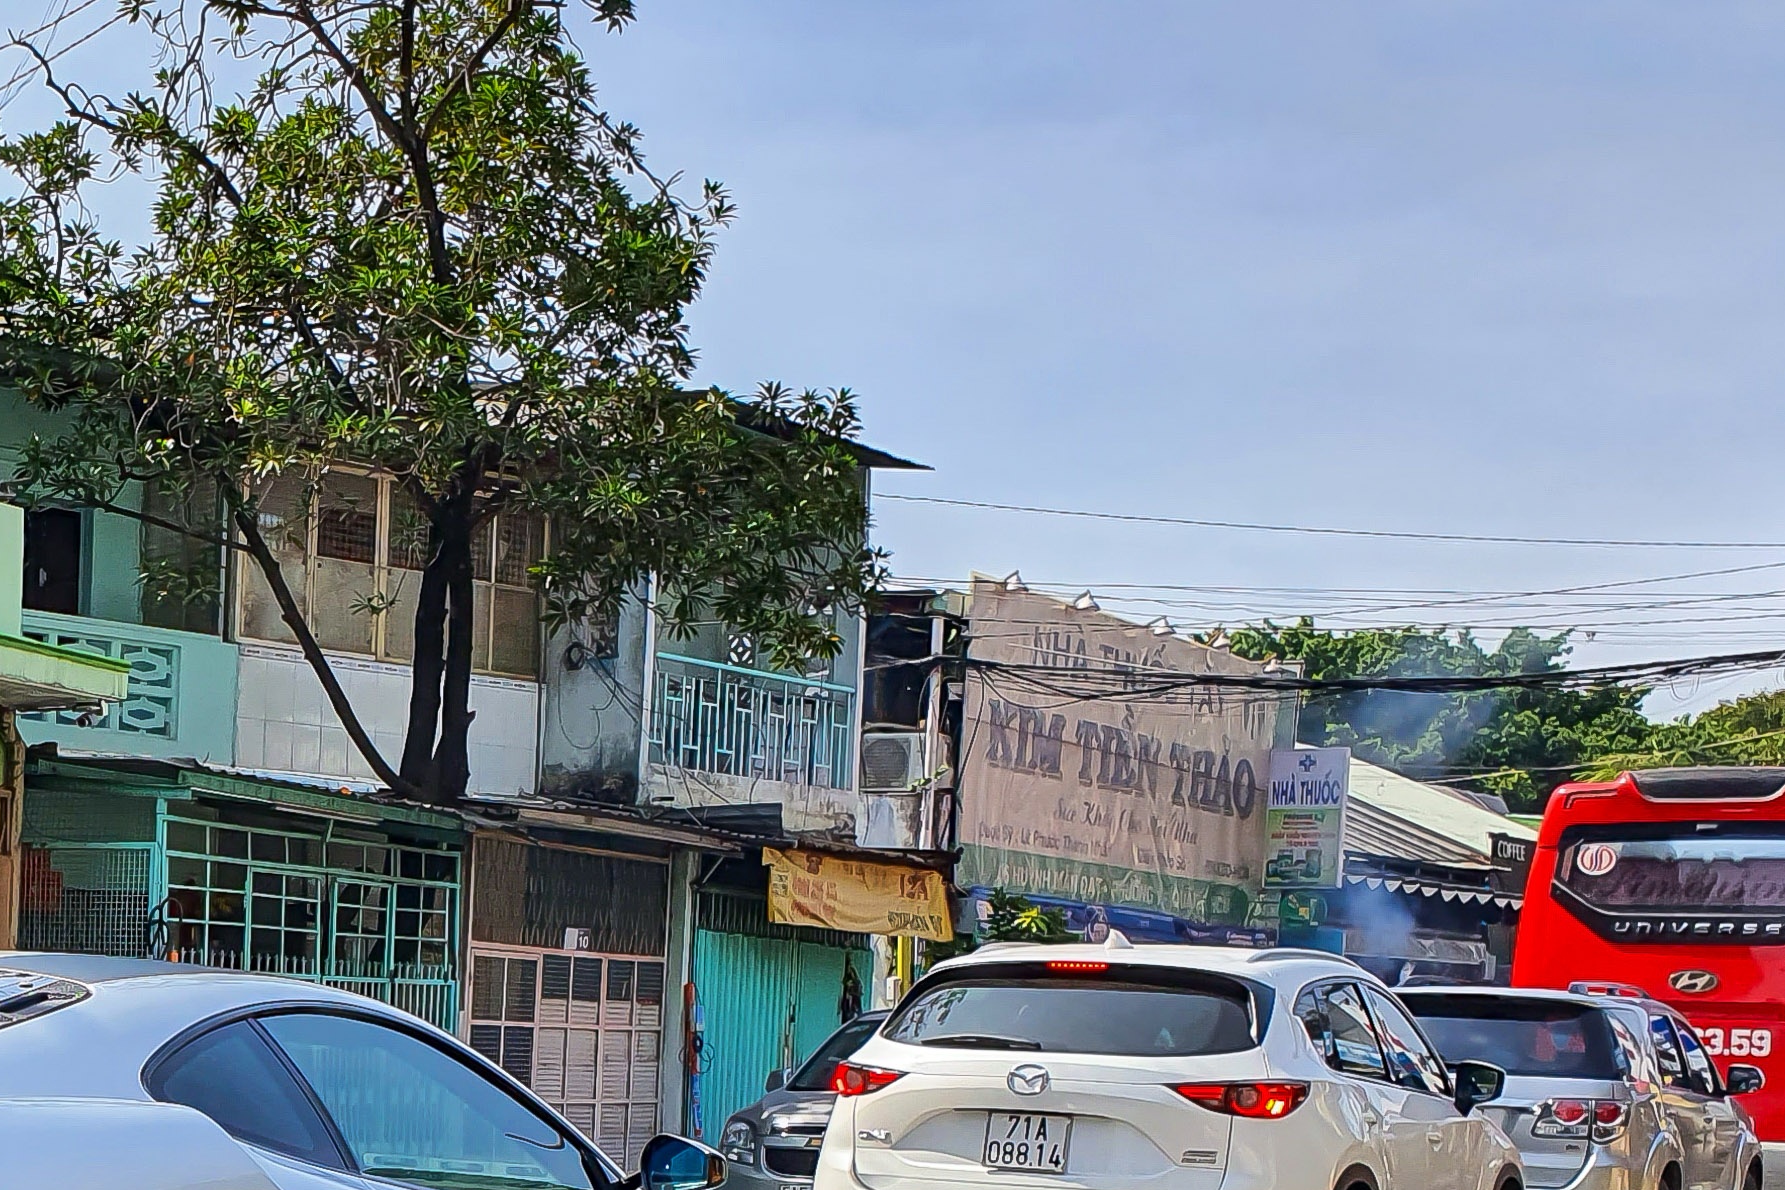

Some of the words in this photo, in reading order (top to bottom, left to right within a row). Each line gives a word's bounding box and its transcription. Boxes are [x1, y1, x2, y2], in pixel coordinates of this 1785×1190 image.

[1272, 772, 1296, 805] NHÀ
[1300, 769, 1341, 805] THUỐC
[1497, 839, 1526, 862] COFFEE
[1614, 921, 1783, 936] UNIVERSE
[578, 935, 589, 949] 10
[1006, 1115, 1048, 1142] 71A
[987, 1141, 1064, 1169] 088.14
